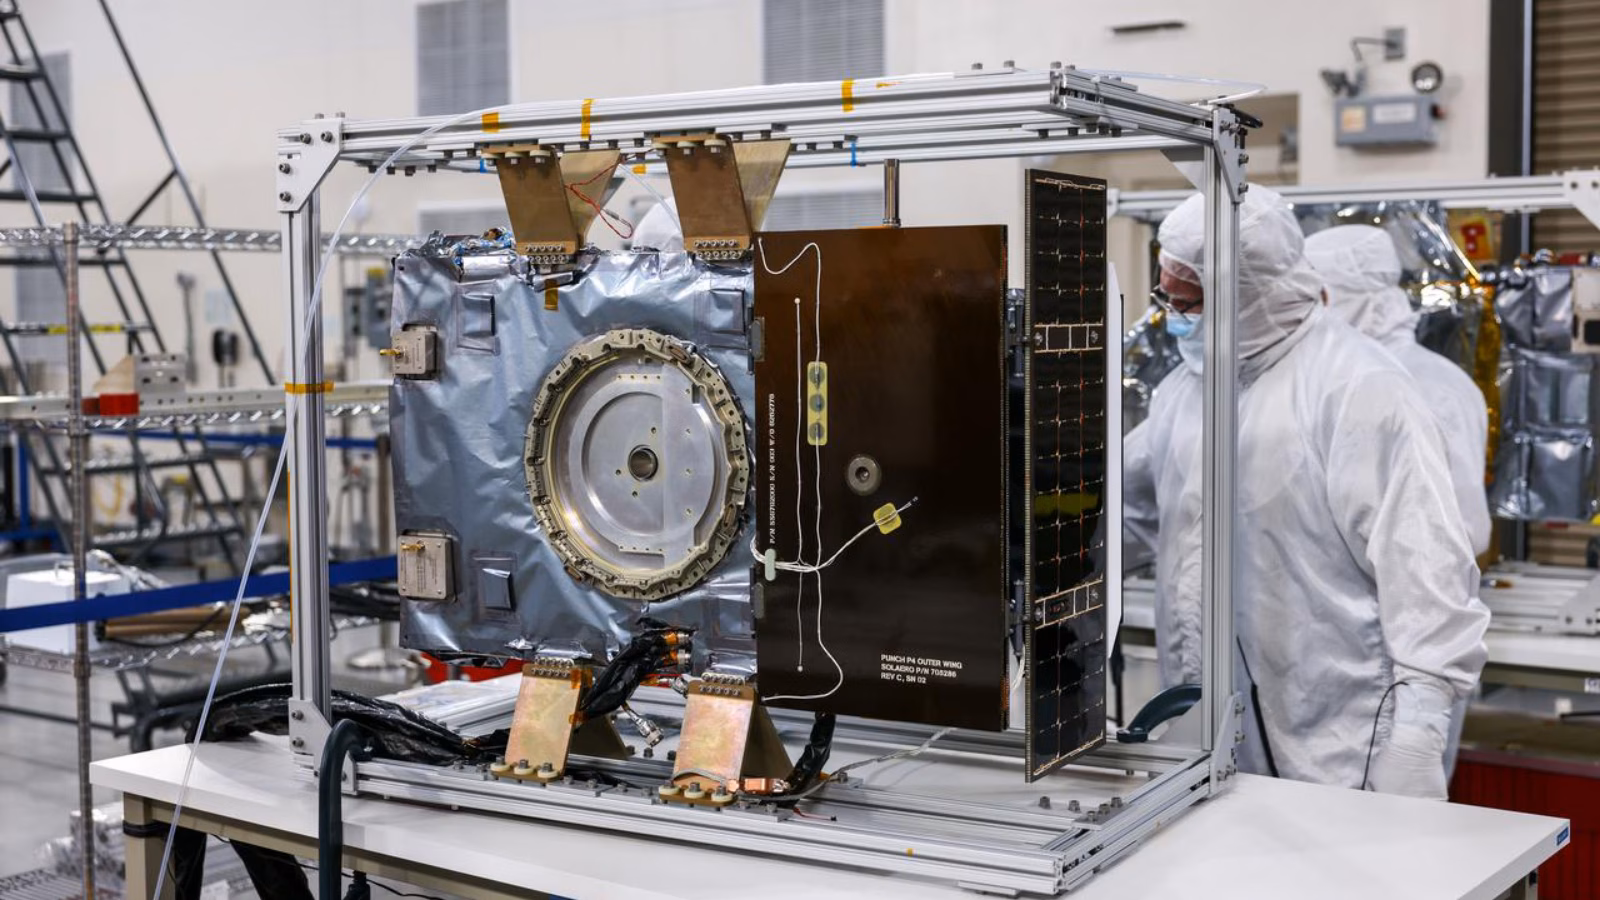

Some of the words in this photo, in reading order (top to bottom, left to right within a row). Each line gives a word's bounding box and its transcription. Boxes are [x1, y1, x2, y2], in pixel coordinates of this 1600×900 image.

[881, 654, 905, 663] PUNCH
[907, 656, 916, 664] P4
[917, 657, 941, 666] OUTER
[943, 660, 962, 669] WING
[881, 663, 915, 673] SOLAERO
[916, 666, 930, 675] P/N
[881, 672, 895, 680] REV
[906, 675, 916, 683] SN
